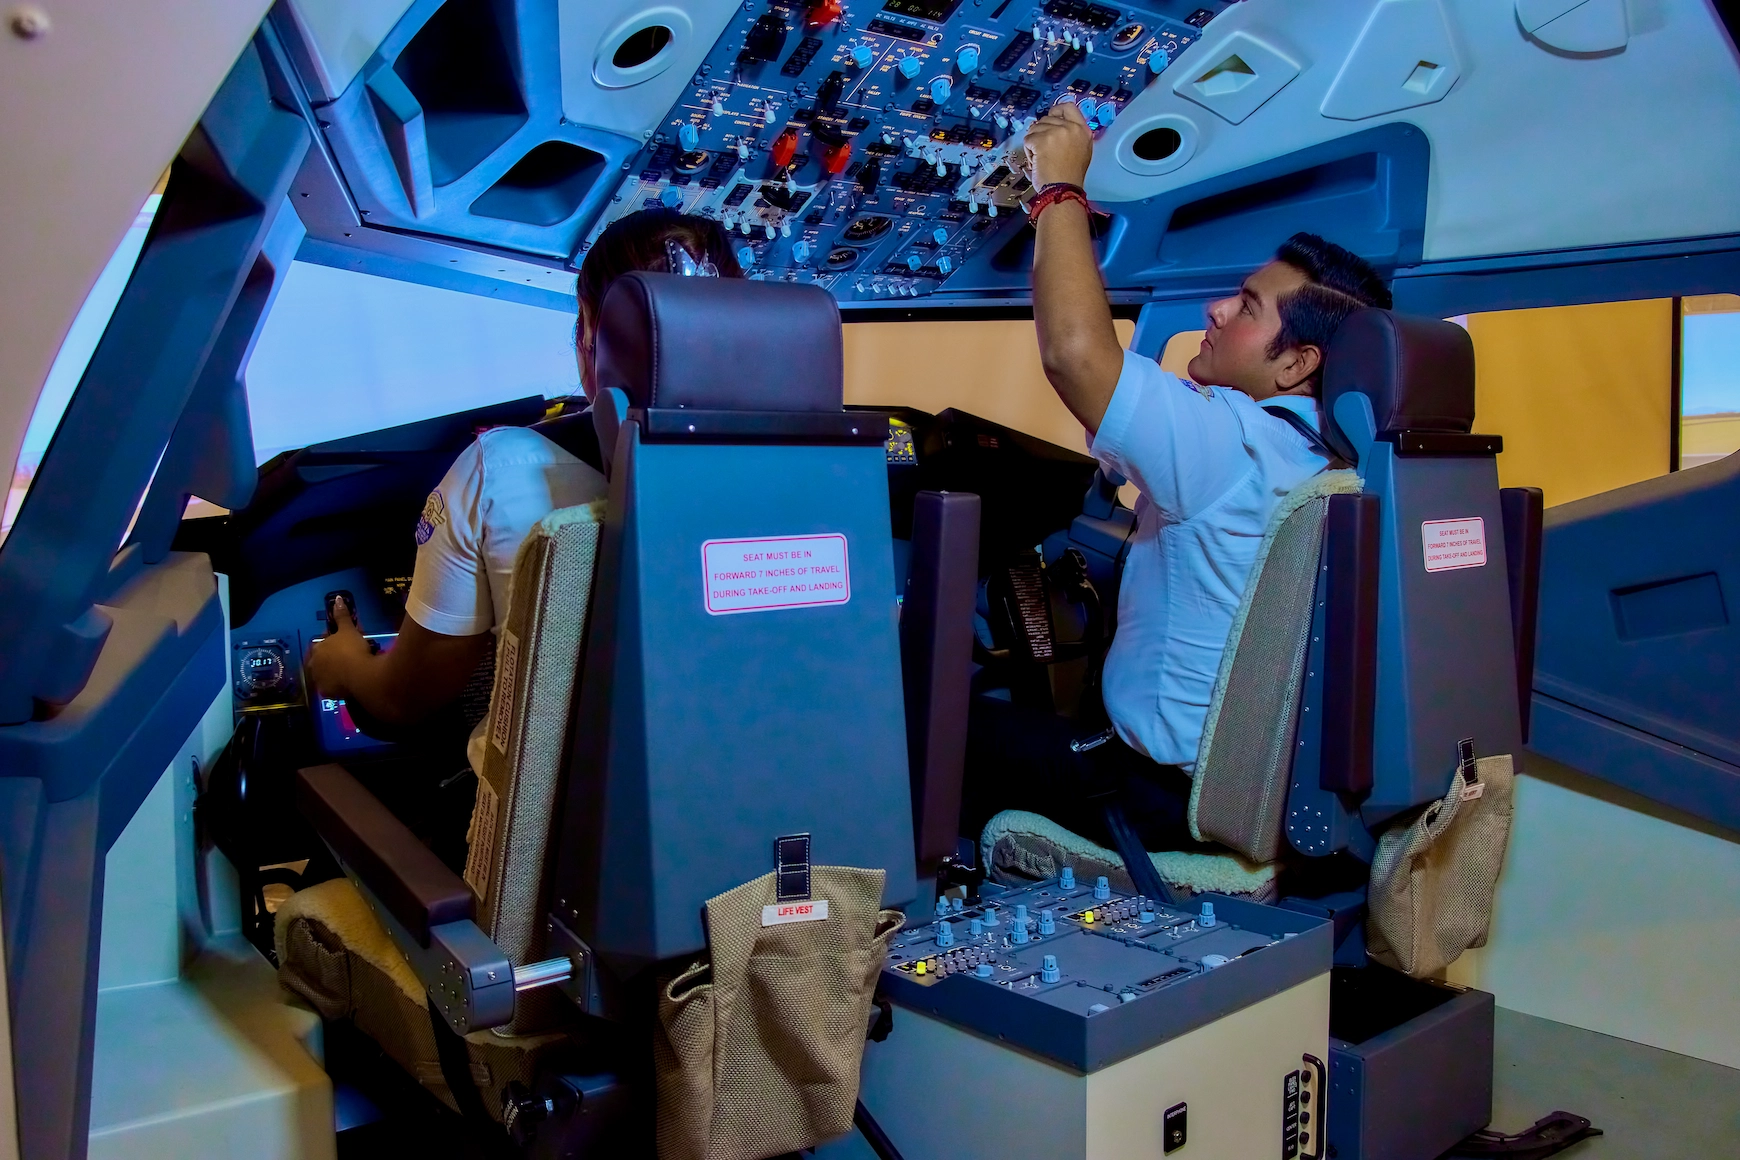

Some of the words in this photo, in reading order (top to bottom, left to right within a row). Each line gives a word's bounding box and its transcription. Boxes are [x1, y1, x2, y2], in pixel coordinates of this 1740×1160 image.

[743, 553, 764, 562] SEAT
[766, 552, 788, 560] MUST
[714, 571, 756, 581] FORWARD
[766, 568, 795, 577] INCHES
[810, 566, 840, 574] TRAVEL
[713, 588, 746, 598] DURING
[748, 586, 787, 596] TAKE-OFF
[809, 582, 843, 591] LANDING
[506, 644, 516, 700] FLOTATION
[502, 676, 508, 690] TO
[496, 691, 506, 734] REMOVE
[500, 702, 511, 748] CUSHION
[778, 907, 794, 916] LIFE
[795, 906, 813, 914] VEST
